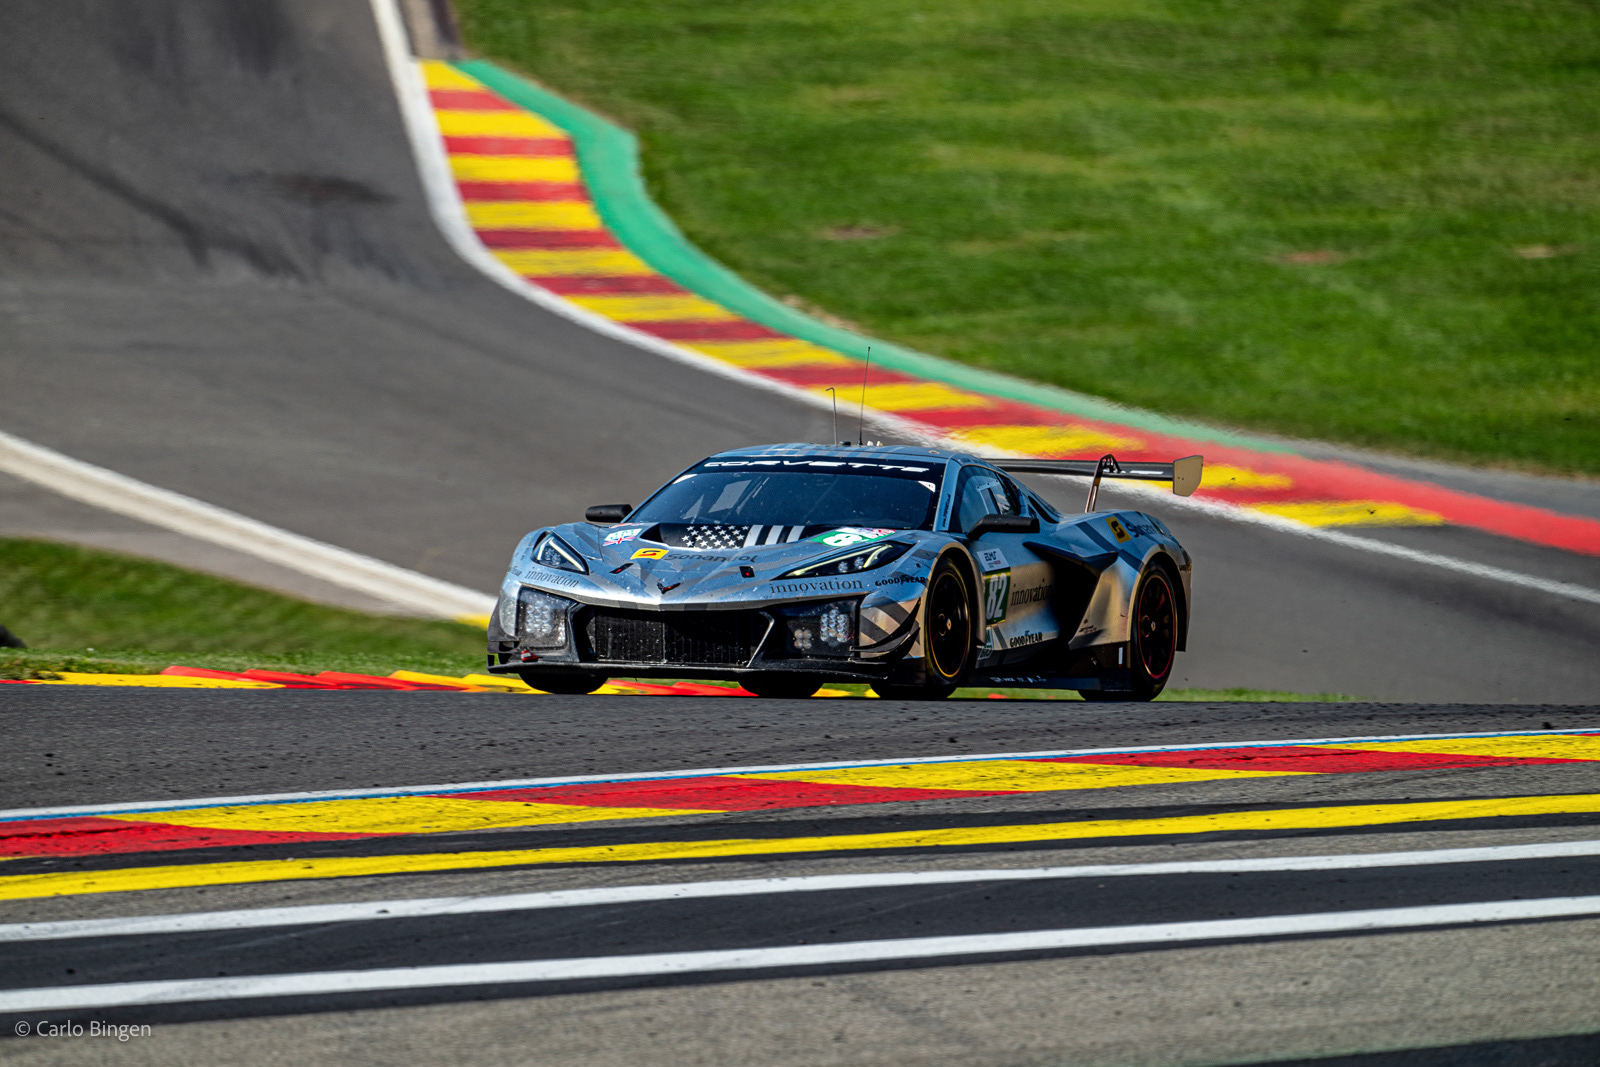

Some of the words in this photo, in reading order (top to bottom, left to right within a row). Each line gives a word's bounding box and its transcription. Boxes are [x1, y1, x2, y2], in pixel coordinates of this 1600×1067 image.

[704, 460, 930, 473] CORVETTE
[525, 567, 580, 588] innovation
[769, 578, 863, 594] innovation
[875, 574, 928, 587] GOODYEAR
[986, 573, 1008, 620] 82
[1010, 630, 1043, 648] GOODYEAR
